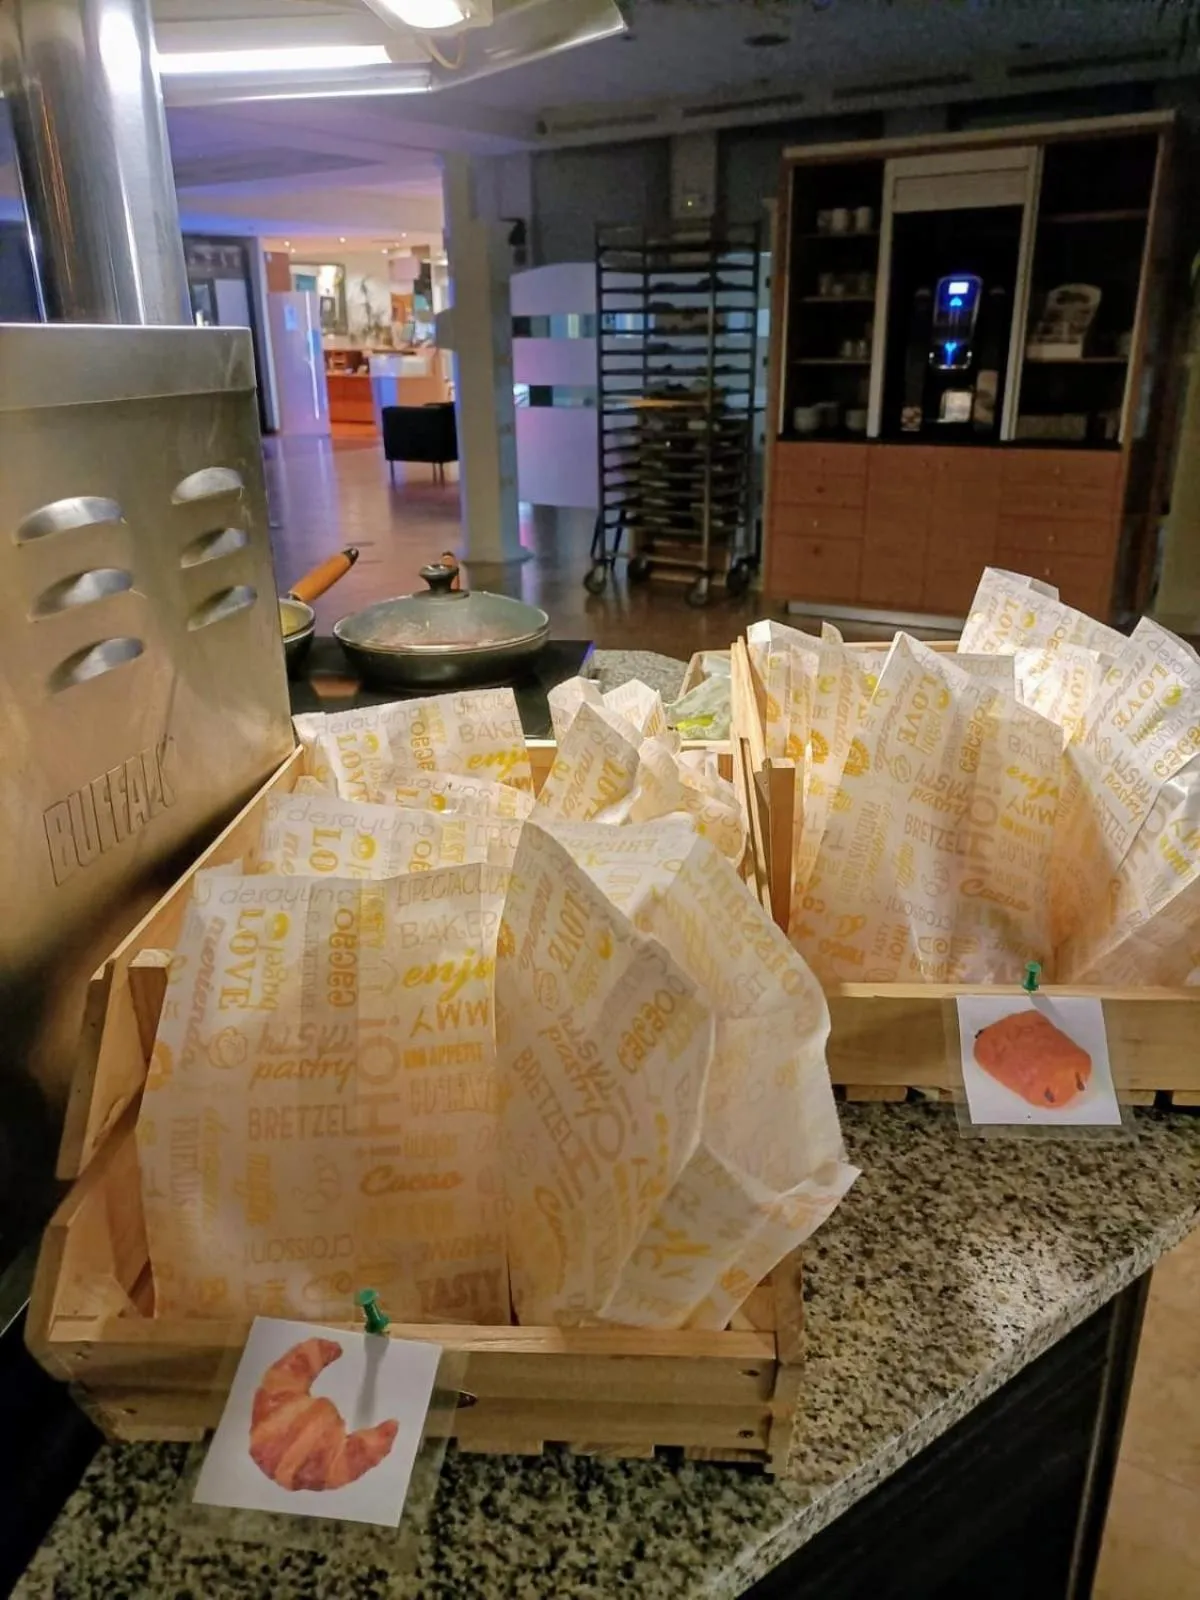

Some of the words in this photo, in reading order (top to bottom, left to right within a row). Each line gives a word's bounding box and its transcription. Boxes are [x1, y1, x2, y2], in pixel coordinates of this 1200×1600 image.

[896, 673, 938, 747] LOVE
[959, 703, 988, 774] cacao
[902, 812, 967, 856] BRETZEL
[218, 908, 266, 1011] LOVE
[260, 943, 288, 1010] bagel
[327, 907, 358, 1008] cacao
[616, 989, 676, 1075] cacao
[248, 1102, 358, 1142] BRETZEL
